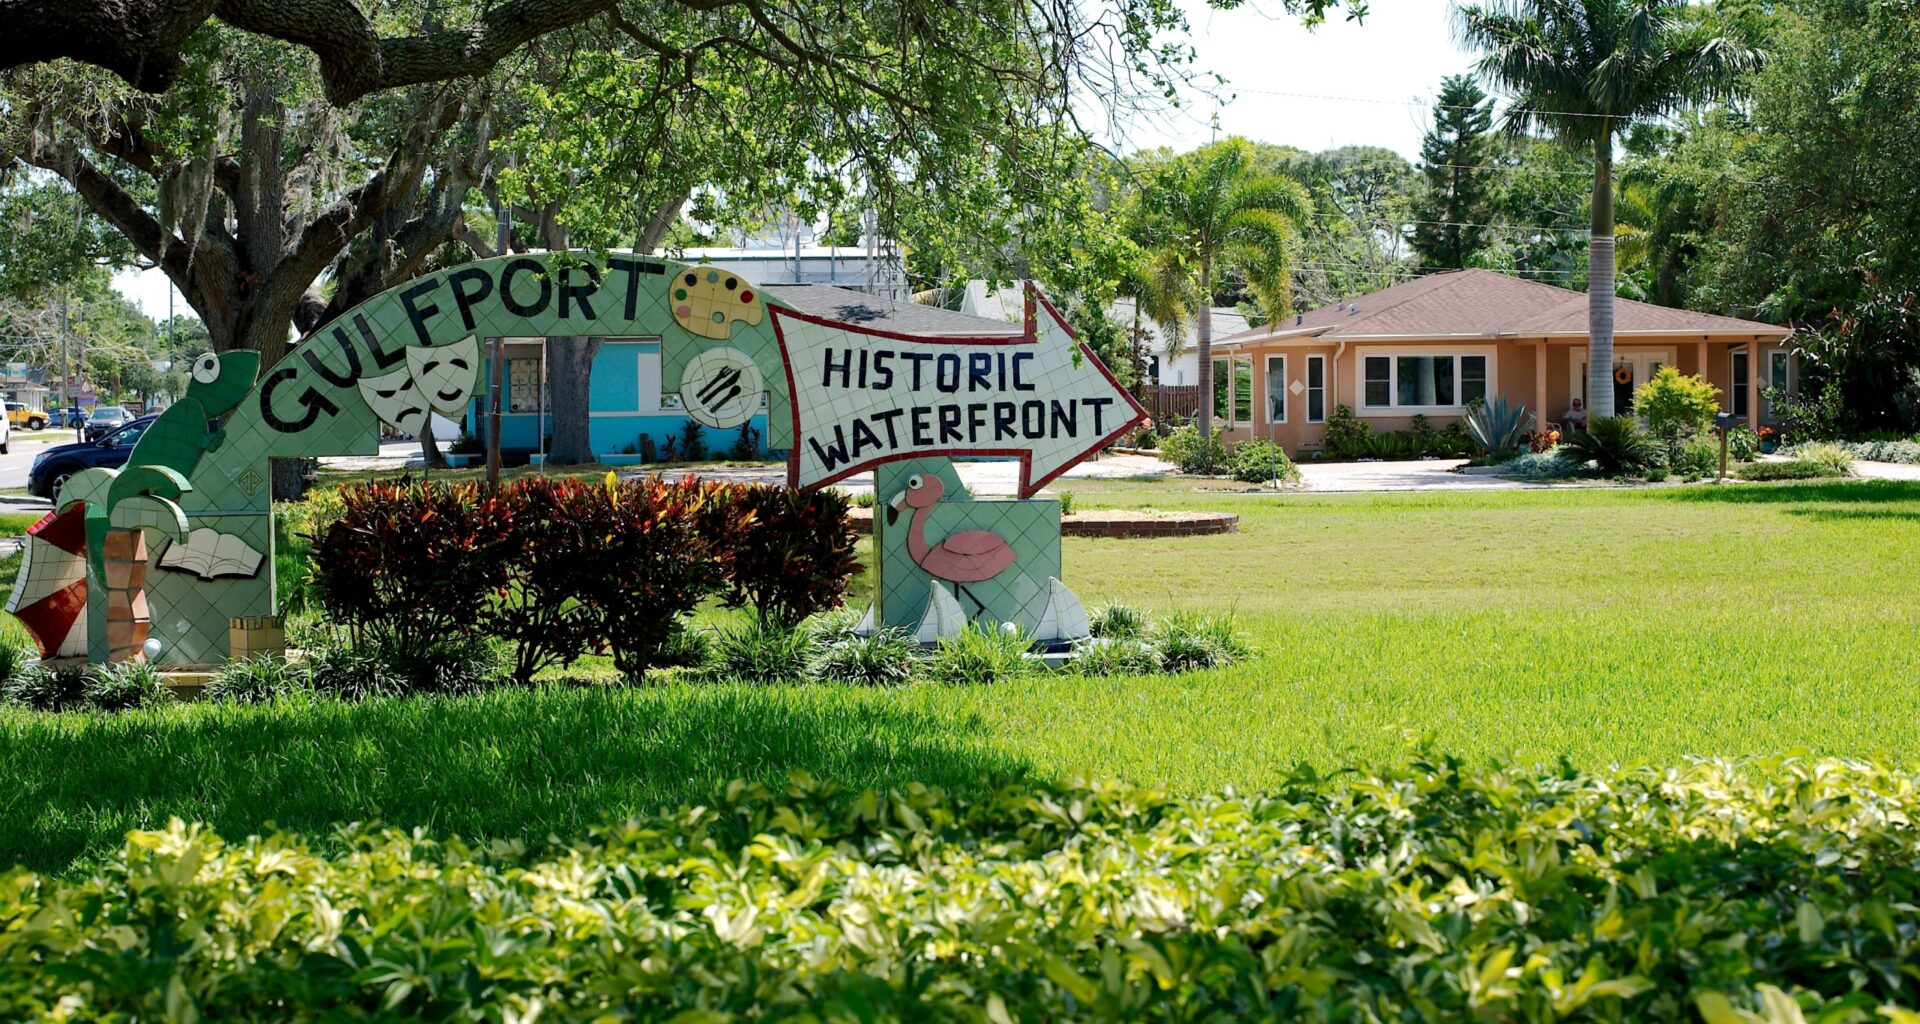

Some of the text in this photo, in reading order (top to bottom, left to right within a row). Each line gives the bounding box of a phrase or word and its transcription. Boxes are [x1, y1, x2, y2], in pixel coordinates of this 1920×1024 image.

[260, 258, 666, 434] GULFPORT
[822, 347, 1036, 393] HISTORIC
[808, 397, 1114, 472] WATERFRONT
